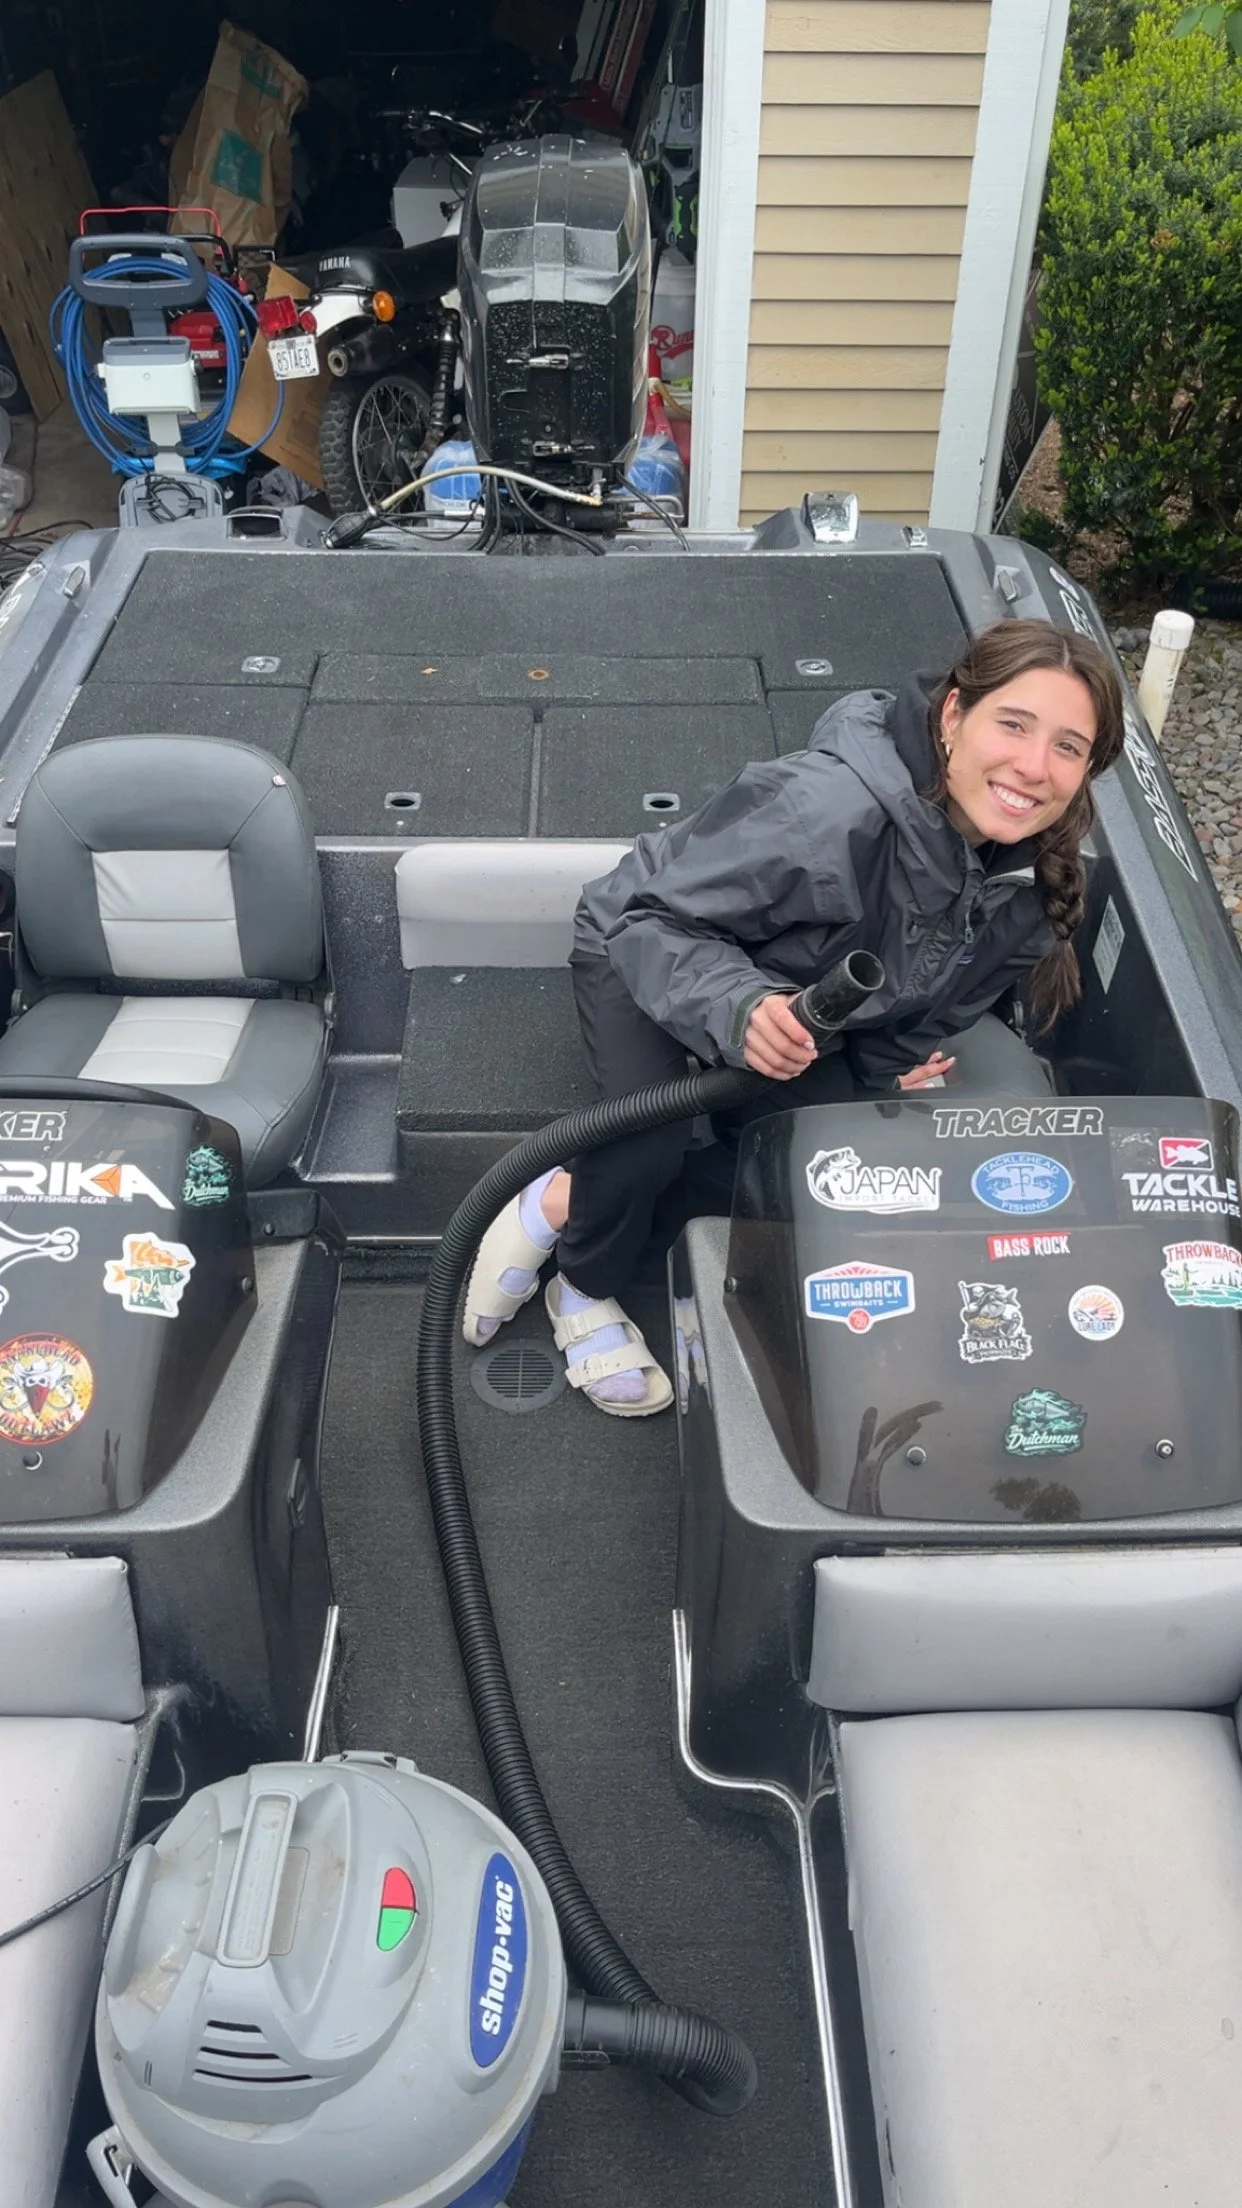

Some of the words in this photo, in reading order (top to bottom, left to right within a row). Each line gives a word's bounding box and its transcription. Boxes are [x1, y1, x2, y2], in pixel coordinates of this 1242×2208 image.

[319, 256, 351, 272] YAMAHA
[933, 1107, 1103, 1138] TRACKER
[983, 1155, 1060, 1175] TACKLEHEAD
[841, 1169, 937, 1195] JAPAN
[1121, 1173, 1238, 1202] TACKLE
[38, 1195, 77, 1204] FISHING
[80, 1196, 107, 1204] GEAR
[1001, 1200, 1049, 1213] FISHING
[1132, 1199, 1241, 1218] WAREHOUSE
[994, 1238, 1030, 1258] BASS
[1033, 1236, 1070, 1256] ROCK
[815, 1280, 902, 1300] THROWBACK
[966, 1341, 997, 1353] BLACK
[998, 1339, 1025, 1350] FLAG
[1006, 1430, 1079, 1450] Dutchman
